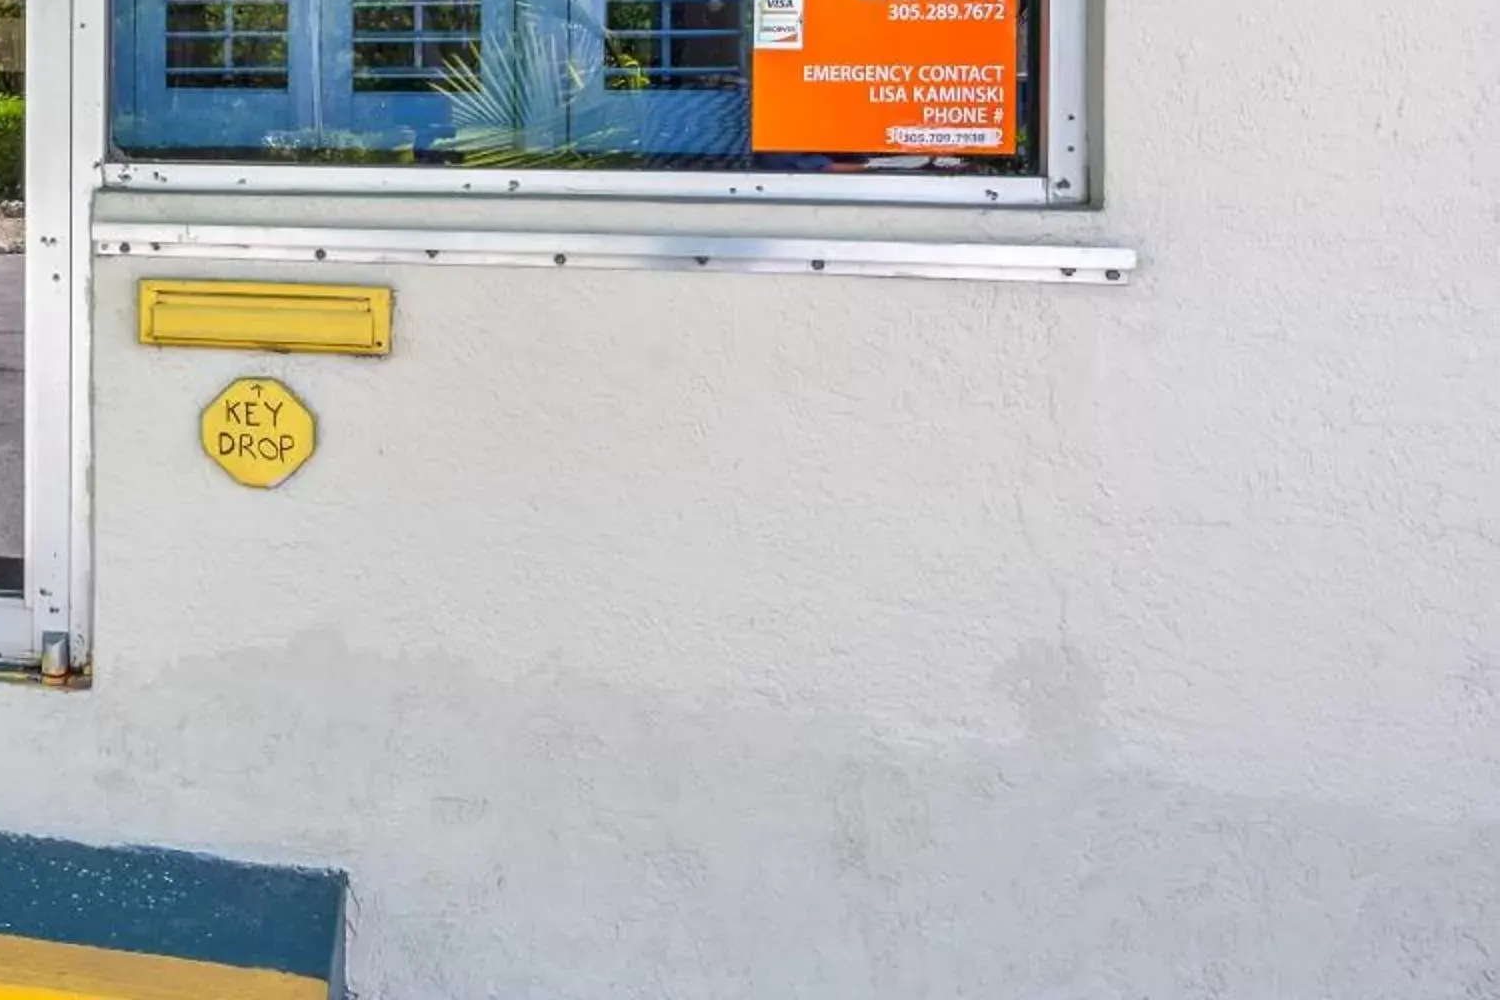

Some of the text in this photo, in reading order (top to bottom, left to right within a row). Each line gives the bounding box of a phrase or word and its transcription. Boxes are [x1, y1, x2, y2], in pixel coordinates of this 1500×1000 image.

[766, 0, 794, 9] VISA
[887, 3, 1005, 21] 305.289.7672
[803, 64, 1005, 82] EMERGENCY CONTACT
[869, 84, 1004, 103] LISA KAMINSKI
[923, 106, 1004, 124] PHONE #
[225, 399, 284, 428] KEY
[217, 432, 296, 464] DROP
